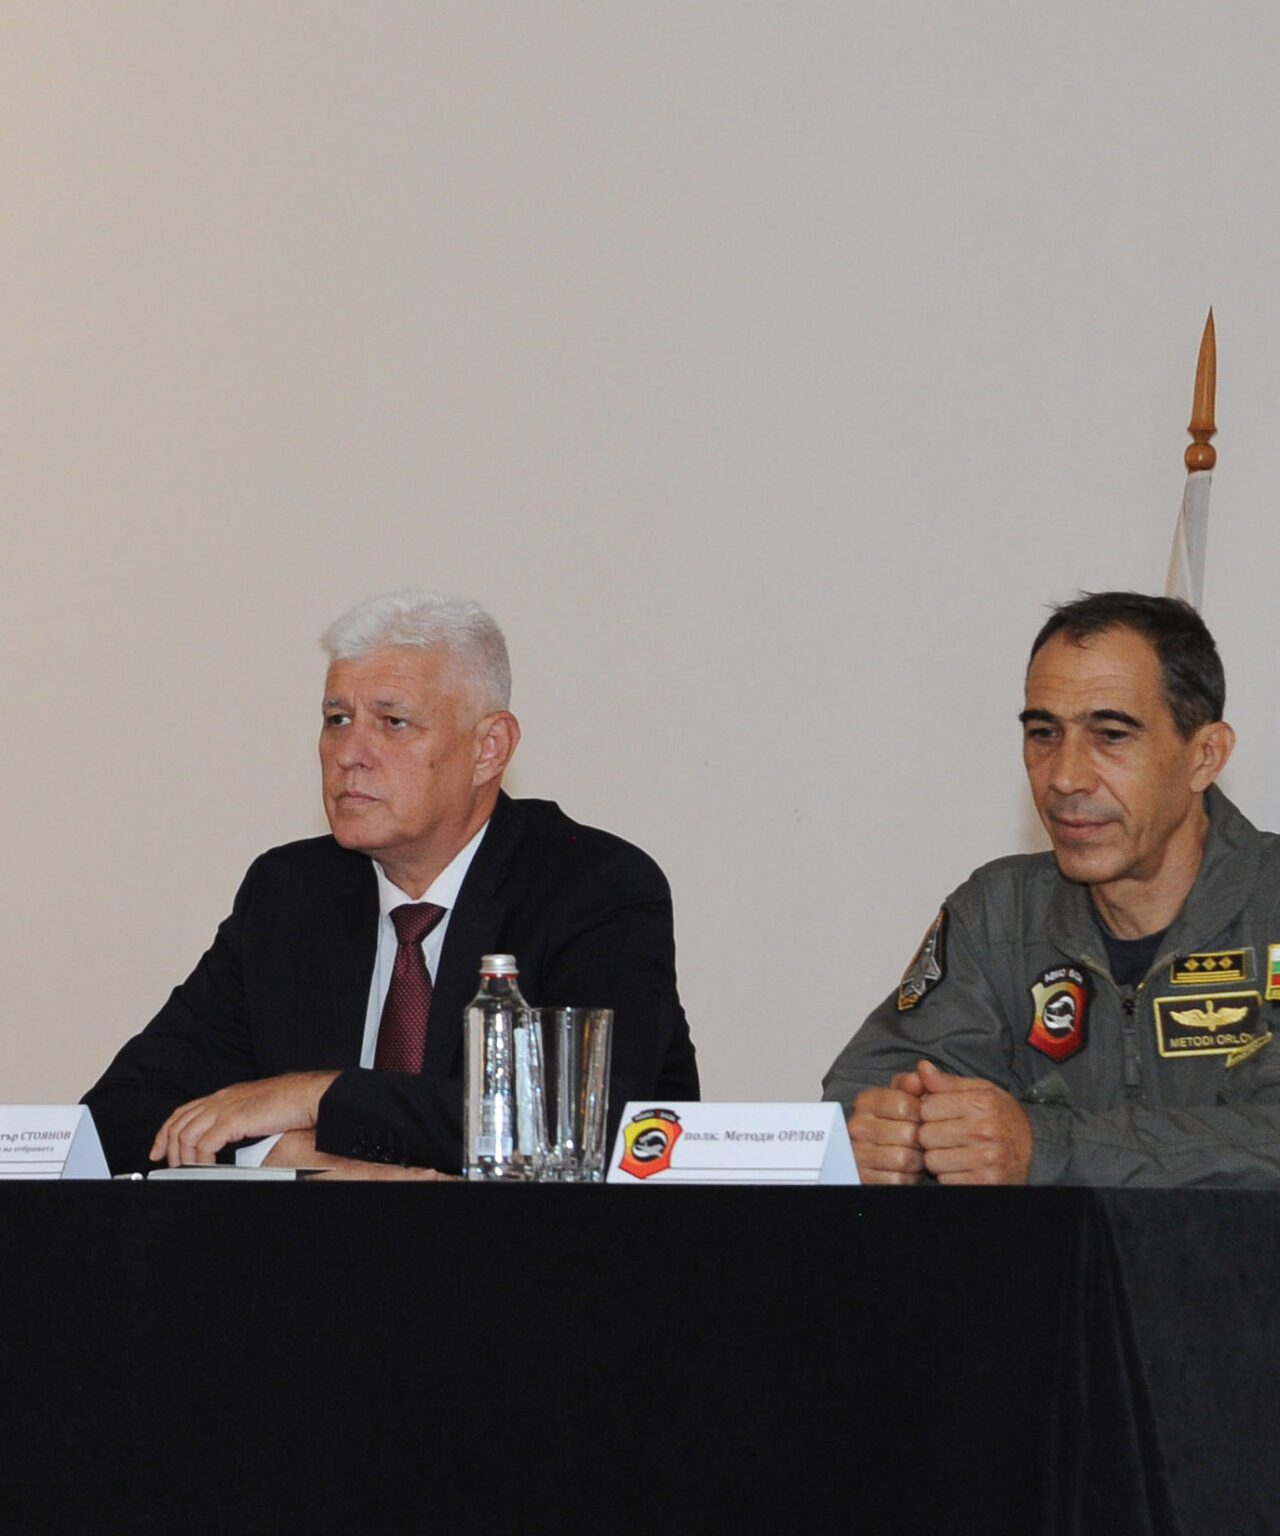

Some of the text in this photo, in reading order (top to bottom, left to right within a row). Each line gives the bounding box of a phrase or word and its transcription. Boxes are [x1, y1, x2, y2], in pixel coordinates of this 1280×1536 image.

[1170, 1035, 1214, 1048] METODI
[20, 1131, 72, 1140] СТОЯНОВ
[723, 1130, 775, 1142] Методи
[778, 1130, 825, 1141] ОРЛОВ
